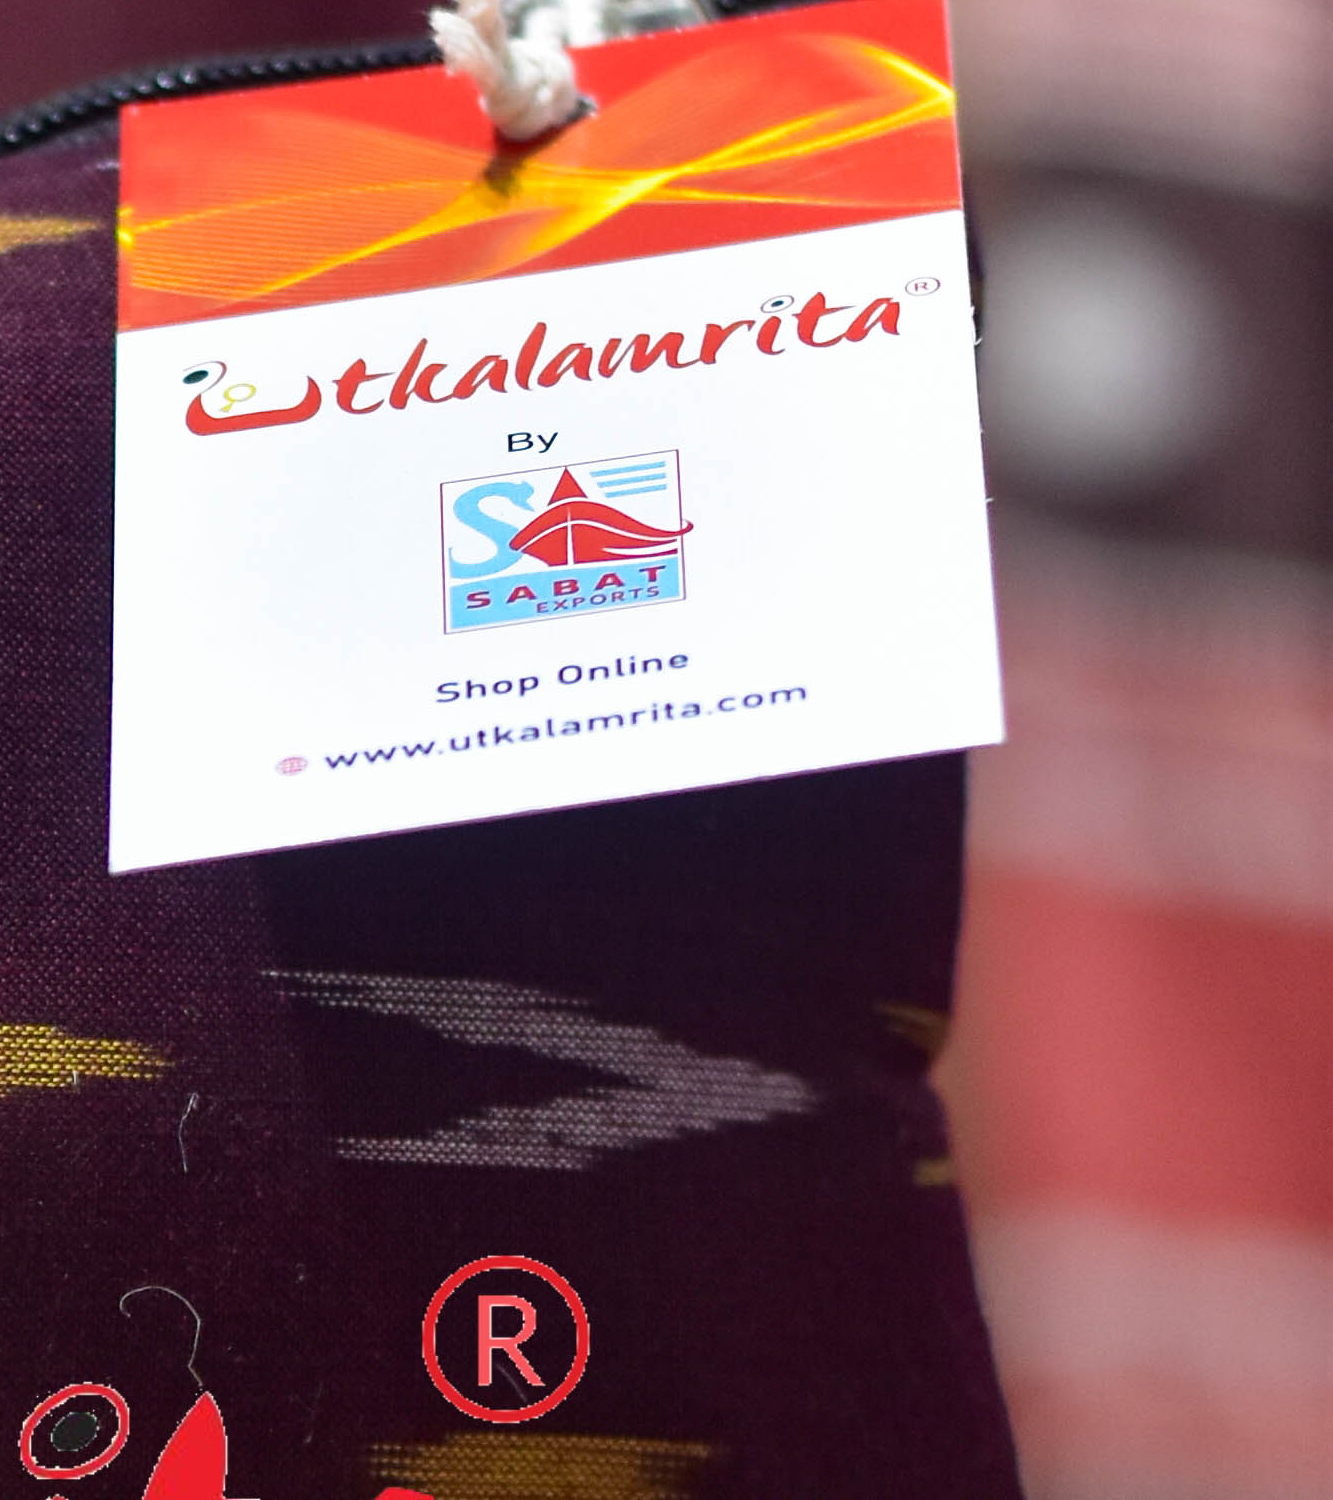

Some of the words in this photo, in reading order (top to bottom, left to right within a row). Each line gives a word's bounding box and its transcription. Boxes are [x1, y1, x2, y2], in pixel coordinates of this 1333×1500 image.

[506, 430, 559, 454] By
[465, 564, 667, 609] SABAT
[535, 585, 661, 614] EXPORTS
[434, 673, 540, 704] Shop
[556, 652, 691, 686] Online
[324, 684, 808, 771] www.utkalamrita.com
